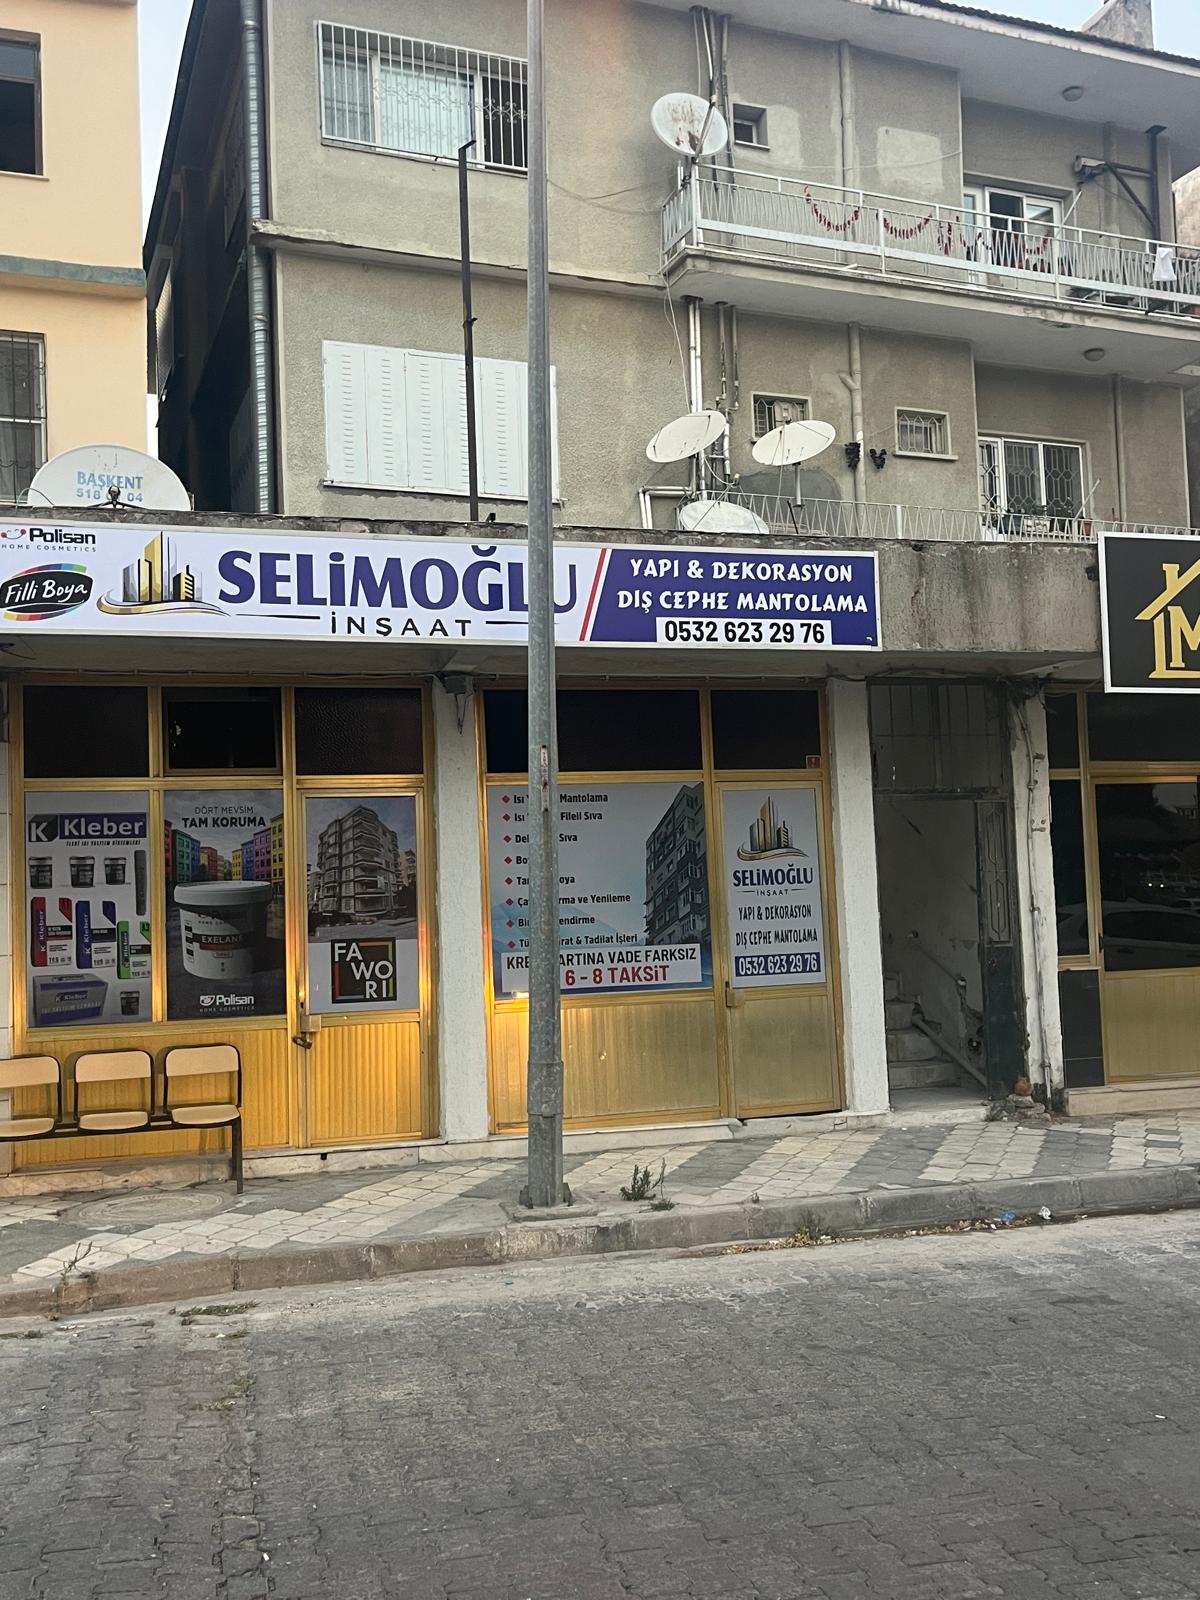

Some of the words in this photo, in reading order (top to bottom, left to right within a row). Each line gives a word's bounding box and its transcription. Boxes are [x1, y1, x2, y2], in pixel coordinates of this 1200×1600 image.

[77, 471, 143, 490] BAŞKENT
[76, 488, 100, 500] 518
[127, 492, 143, 502] 04
[29, 528, 96, 545] Polisan
[36, 545, 96, 553] COSMETICS
[630, 558, 679, 578] YAPI
[686, 560, 703, 579] &
[712, 562, 852, 582] DEKORASYON
[5, 580, 38, 604] Filli
[42, 580, 88, 603] Boya
[617, 590, 652, 613] DIŞ
[659, 591, 729, 611] CEPHE
[736, 593, 868, 612] MANTOLAMA
[331, 611, 472, 637] İNŞAAT
[664, 620, 719, 642] 0532
[724, 621, 764, 643] 623
[769, 622, 795, 643] 29
[800, 622, 825, 643] 76
[513, 794, 525, 804] Isı
[559, 793, 609, 803] Mantolama
[194, 806, 219, 815] DÖRT
[221, 805, 254, 815] MEVSİM
[514, 813, 525, 822] Isı
[560, 812, 582, 821] Fileli
[584, 811, 603, 820] Sıva
[30, 822, 49, 842] K
[64, 817, 144, 836] Kleber
[182, 817, 209, 828] TAM
[212, 816, 267, 828] KORUMA
[558, 833, 578, 842] Sıva
[578, 895, 588, 904] ve
[590, 894, 631, 903] Yenileme
[738, 906, 755, 921] YAPI
[757, 905, 763, 921] &
[765, 904, 812, 920] DEKORASYON
[575, 935, 582, 945] &
[584, 934, 614, 944] Tadilat
[615, 932, 638, 943] İşleri
[735, 931, 748, 950] DIŞ
[749, 930, 772, 946] CEPHE
[774, 928, 818, 944] MANTOLAMA
[608, 951, 642, 964] VADE
[645, 948, 697, 962] FARKSIZ
[738, 956, 766, 975] 0532
[767, 955, 788, 973] 623
[789, 954, 803, 972] 29
[804, 953, 818, 971] 76
[565, 969, 576, 986] 6
[592, 968, 603, 984] 8
[216, 994, 254, 1006] Polisan
